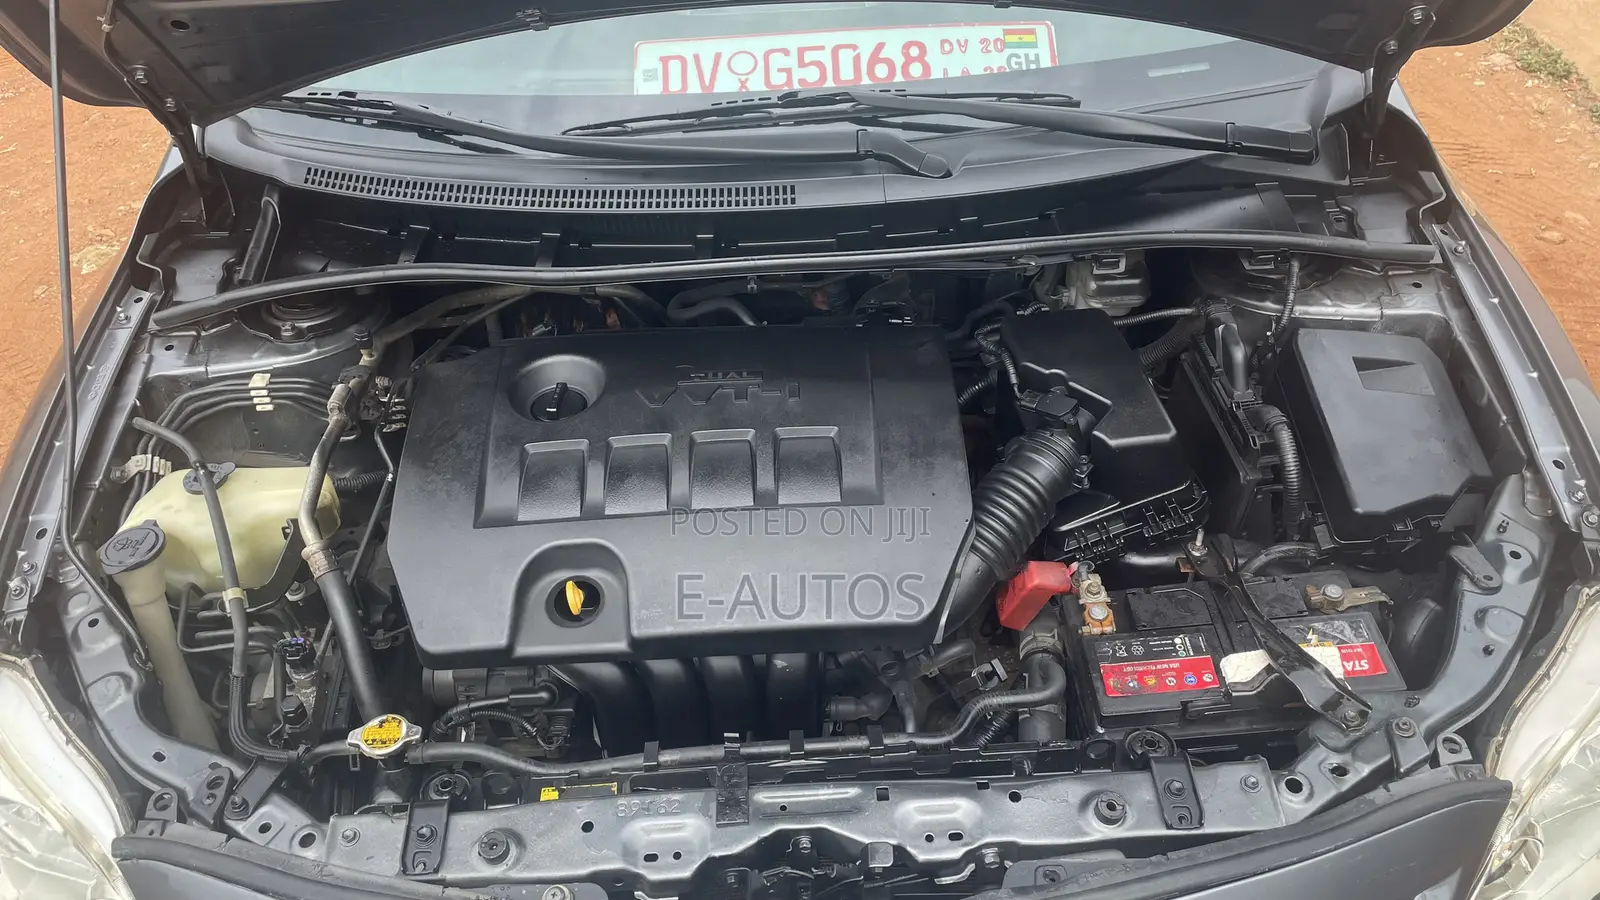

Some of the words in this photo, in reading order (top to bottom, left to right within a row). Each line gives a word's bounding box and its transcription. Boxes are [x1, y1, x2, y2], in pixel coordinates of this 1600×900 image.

[940, 38, 969, 54] DV
[979, 37, 1006, 54] 20
[1006, 52, 1041, 71] GH
[659, 53, 721, 94] DV
